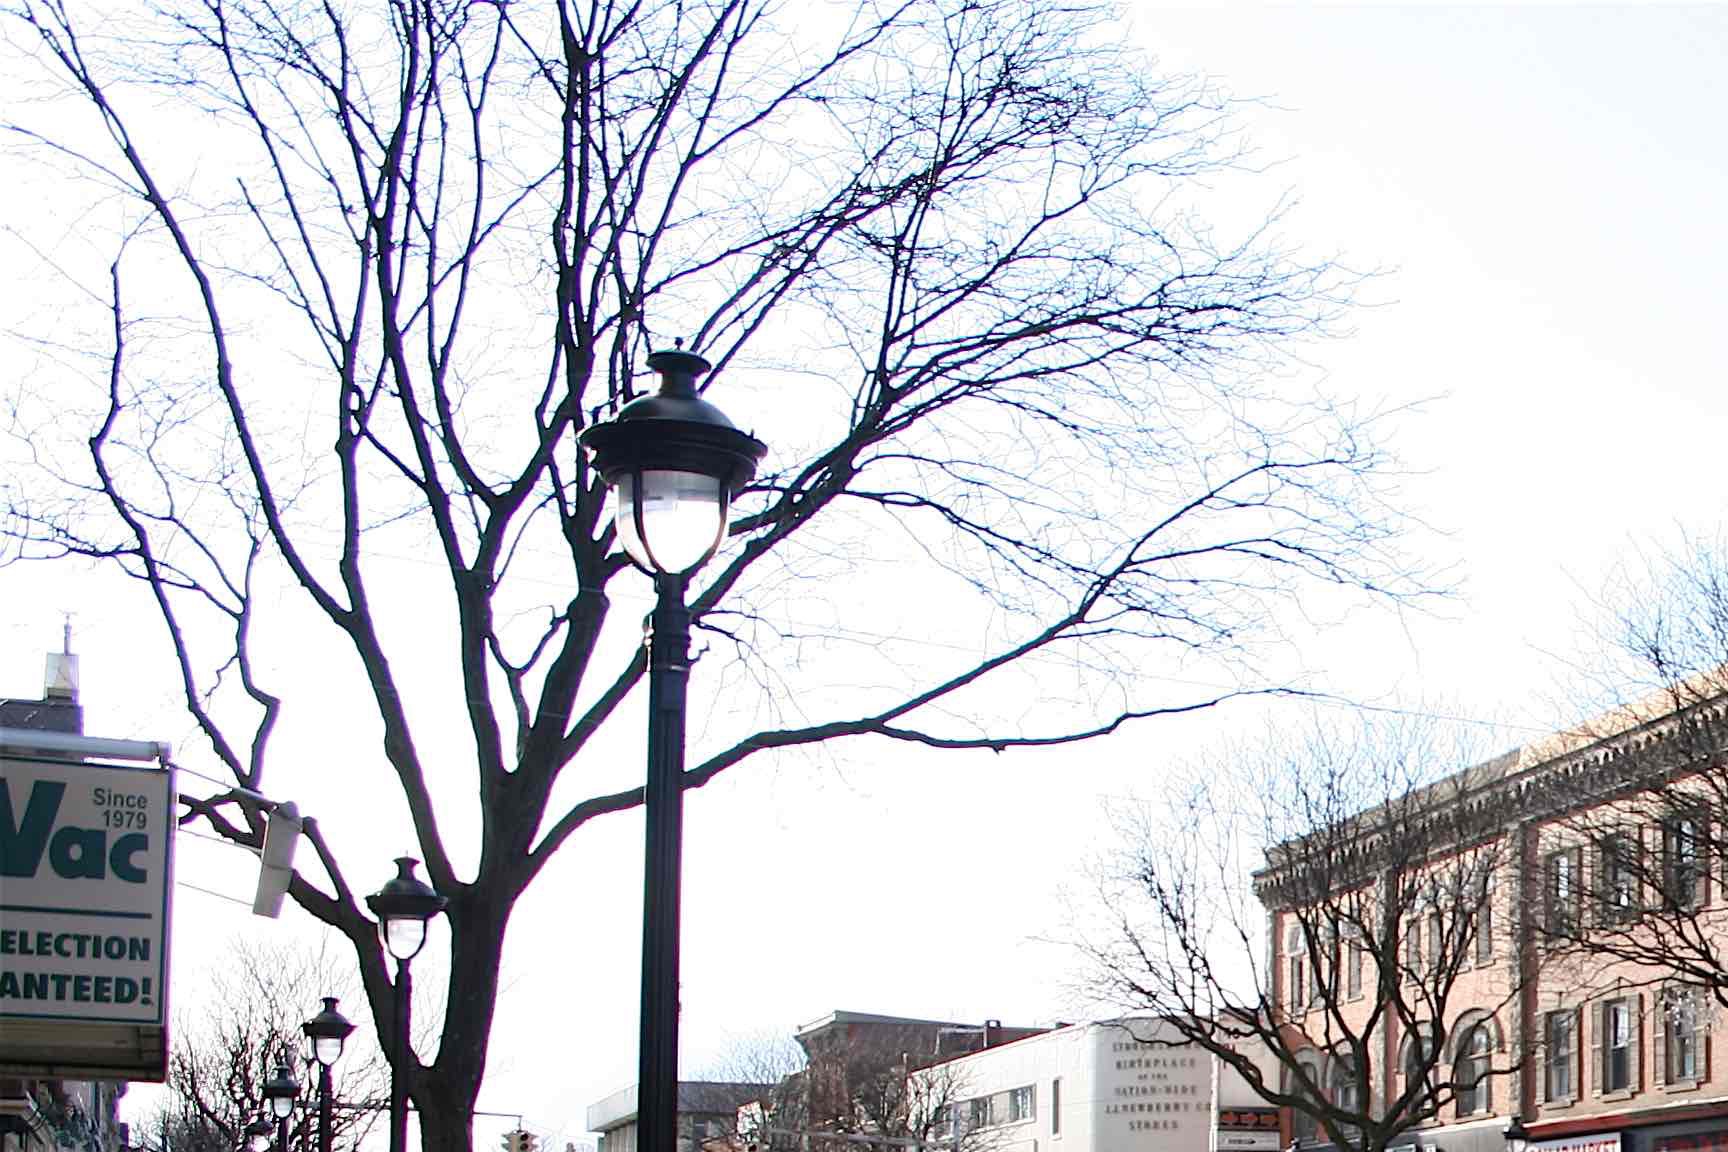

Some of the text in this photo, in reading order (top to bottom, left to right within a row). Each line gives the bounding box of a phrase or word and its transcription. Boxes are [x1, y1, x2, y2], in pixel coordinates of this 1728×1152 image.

[92, 788, 148, 809] Since
[0, 777, 149, 884] Vac
[103, 810, 147, 829] 1979
[0, 928, 150, 961] ELECTION
[0, 971, 153, 1006] ANTEED!
[1115, 1058, 1196, 1070] BIRTHPLACE
